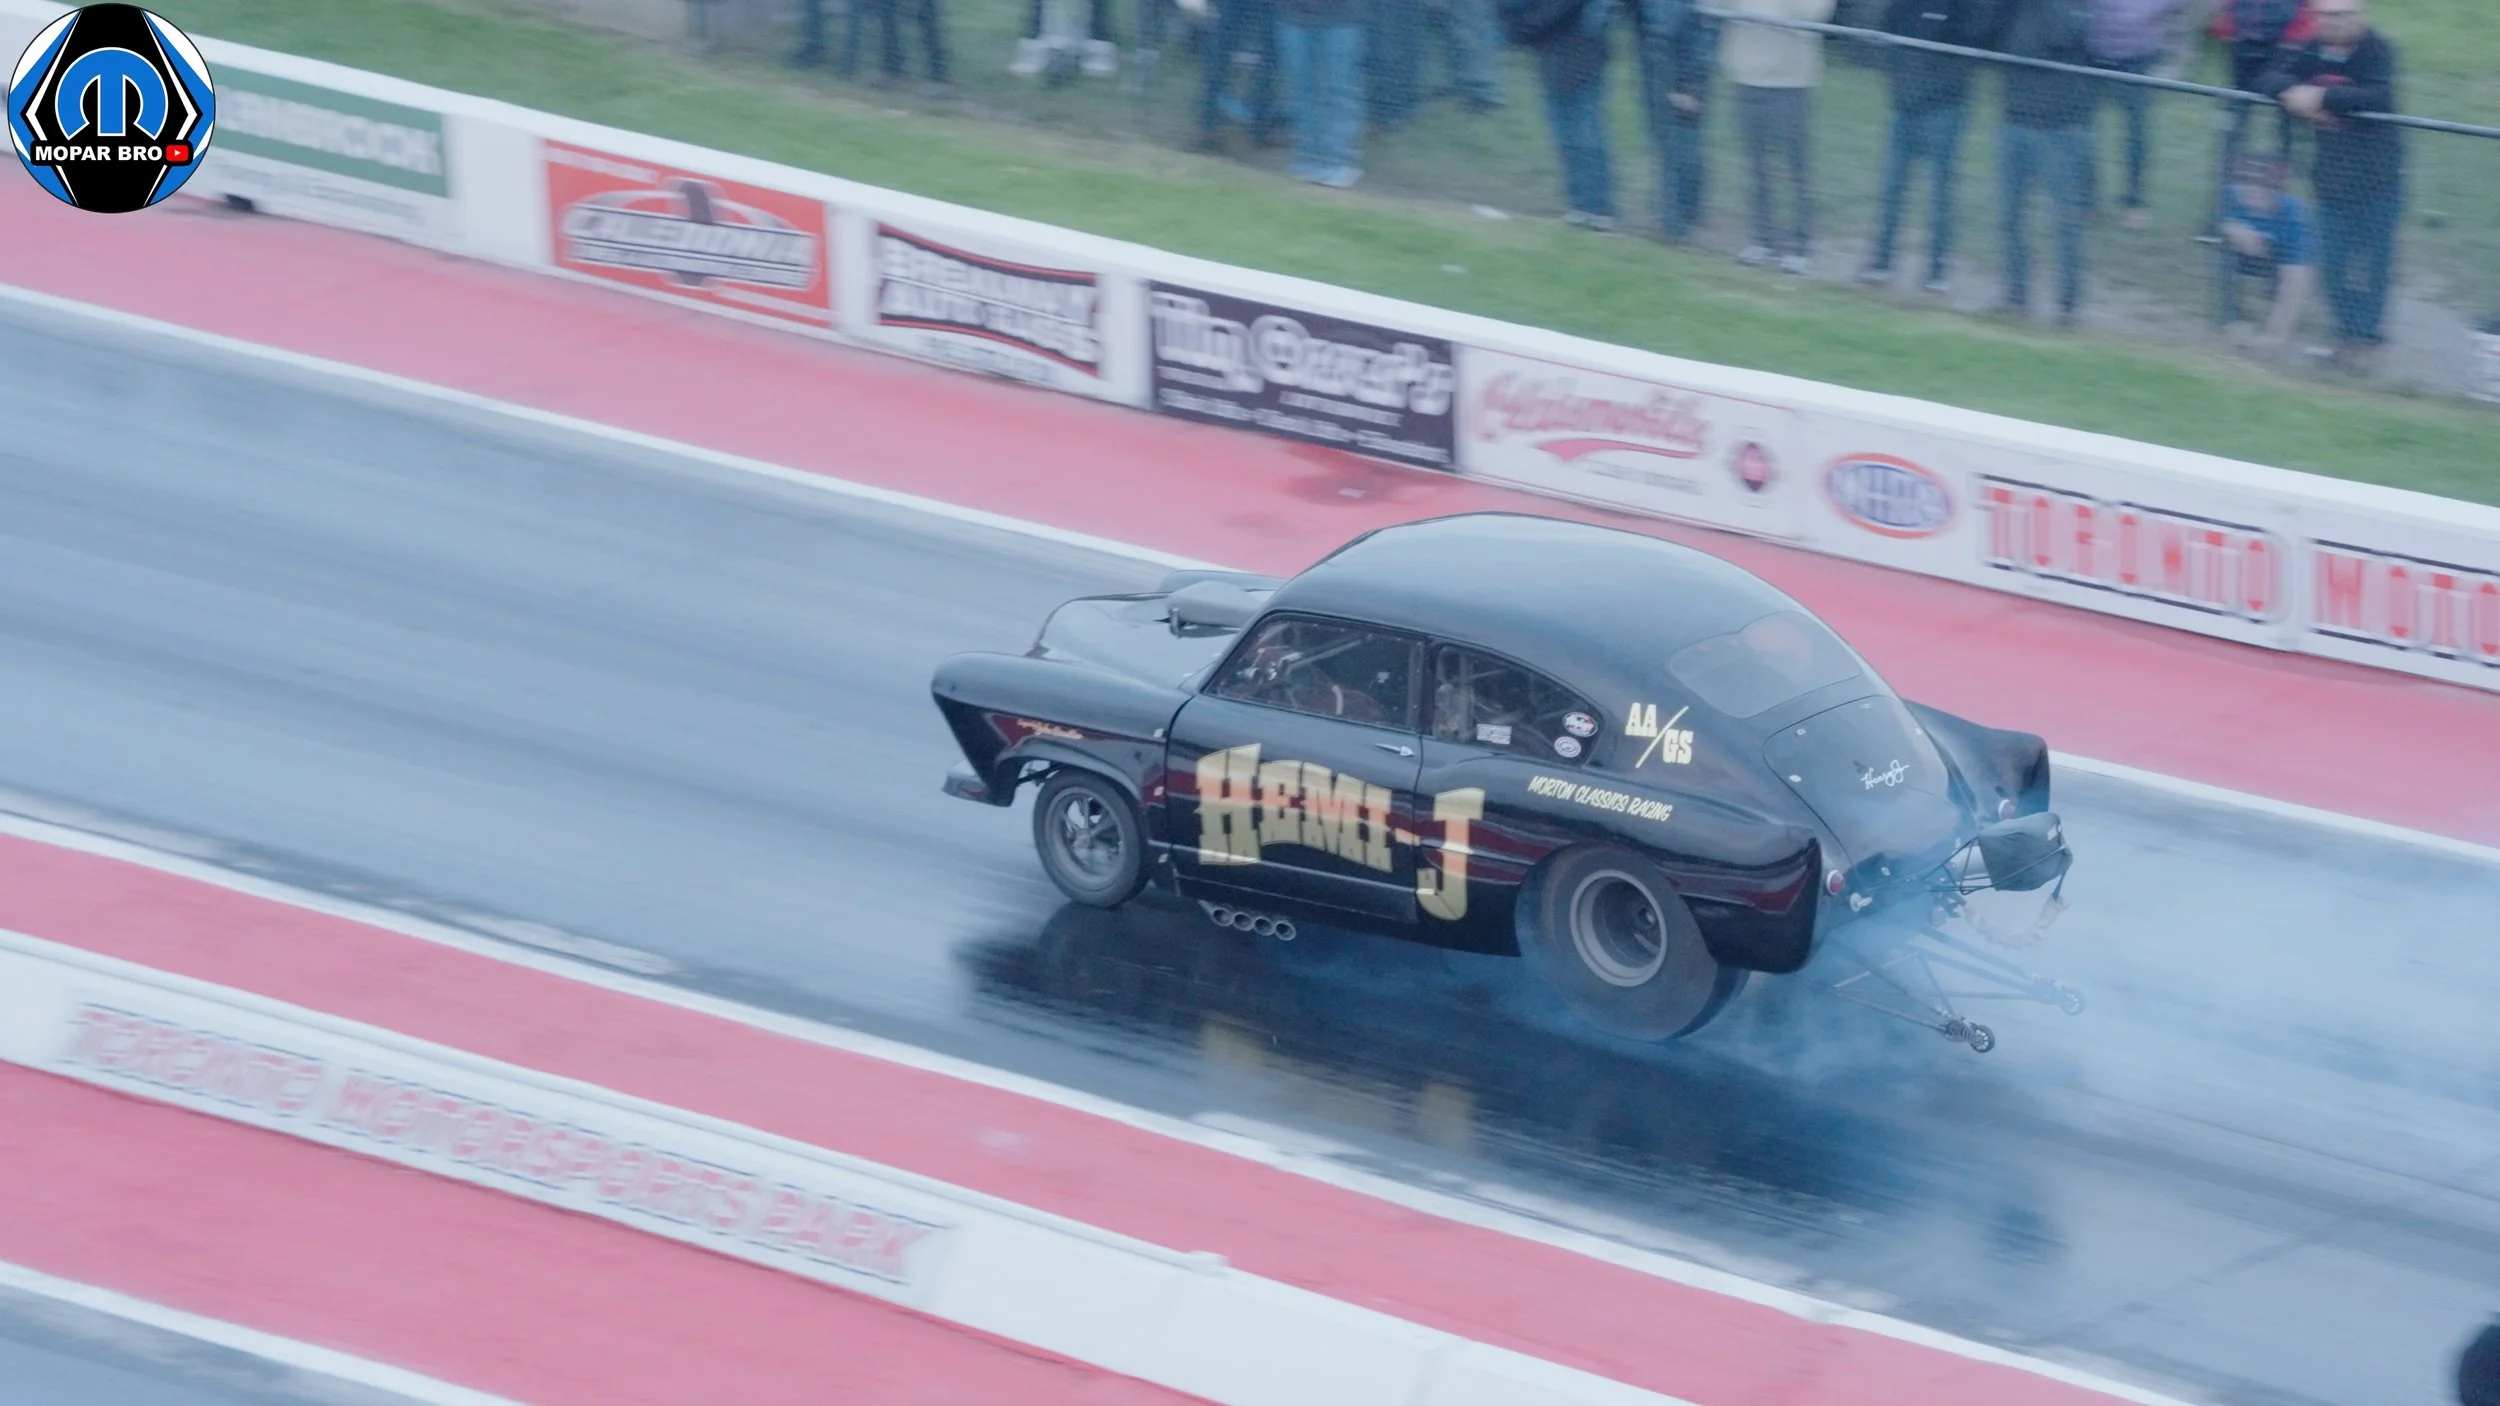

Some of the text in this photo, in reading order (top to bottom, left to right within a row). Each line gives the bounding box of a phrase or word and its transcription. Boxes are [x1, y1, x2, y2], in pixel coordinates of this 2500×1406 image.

[1978, 483, 2284, 616] TORONTO
[1527, 775, 1673, 822] MORTON CLASSICS RACING
[64, 1008, 934, 1279] TORONTO MOTORSPORTS PARK
